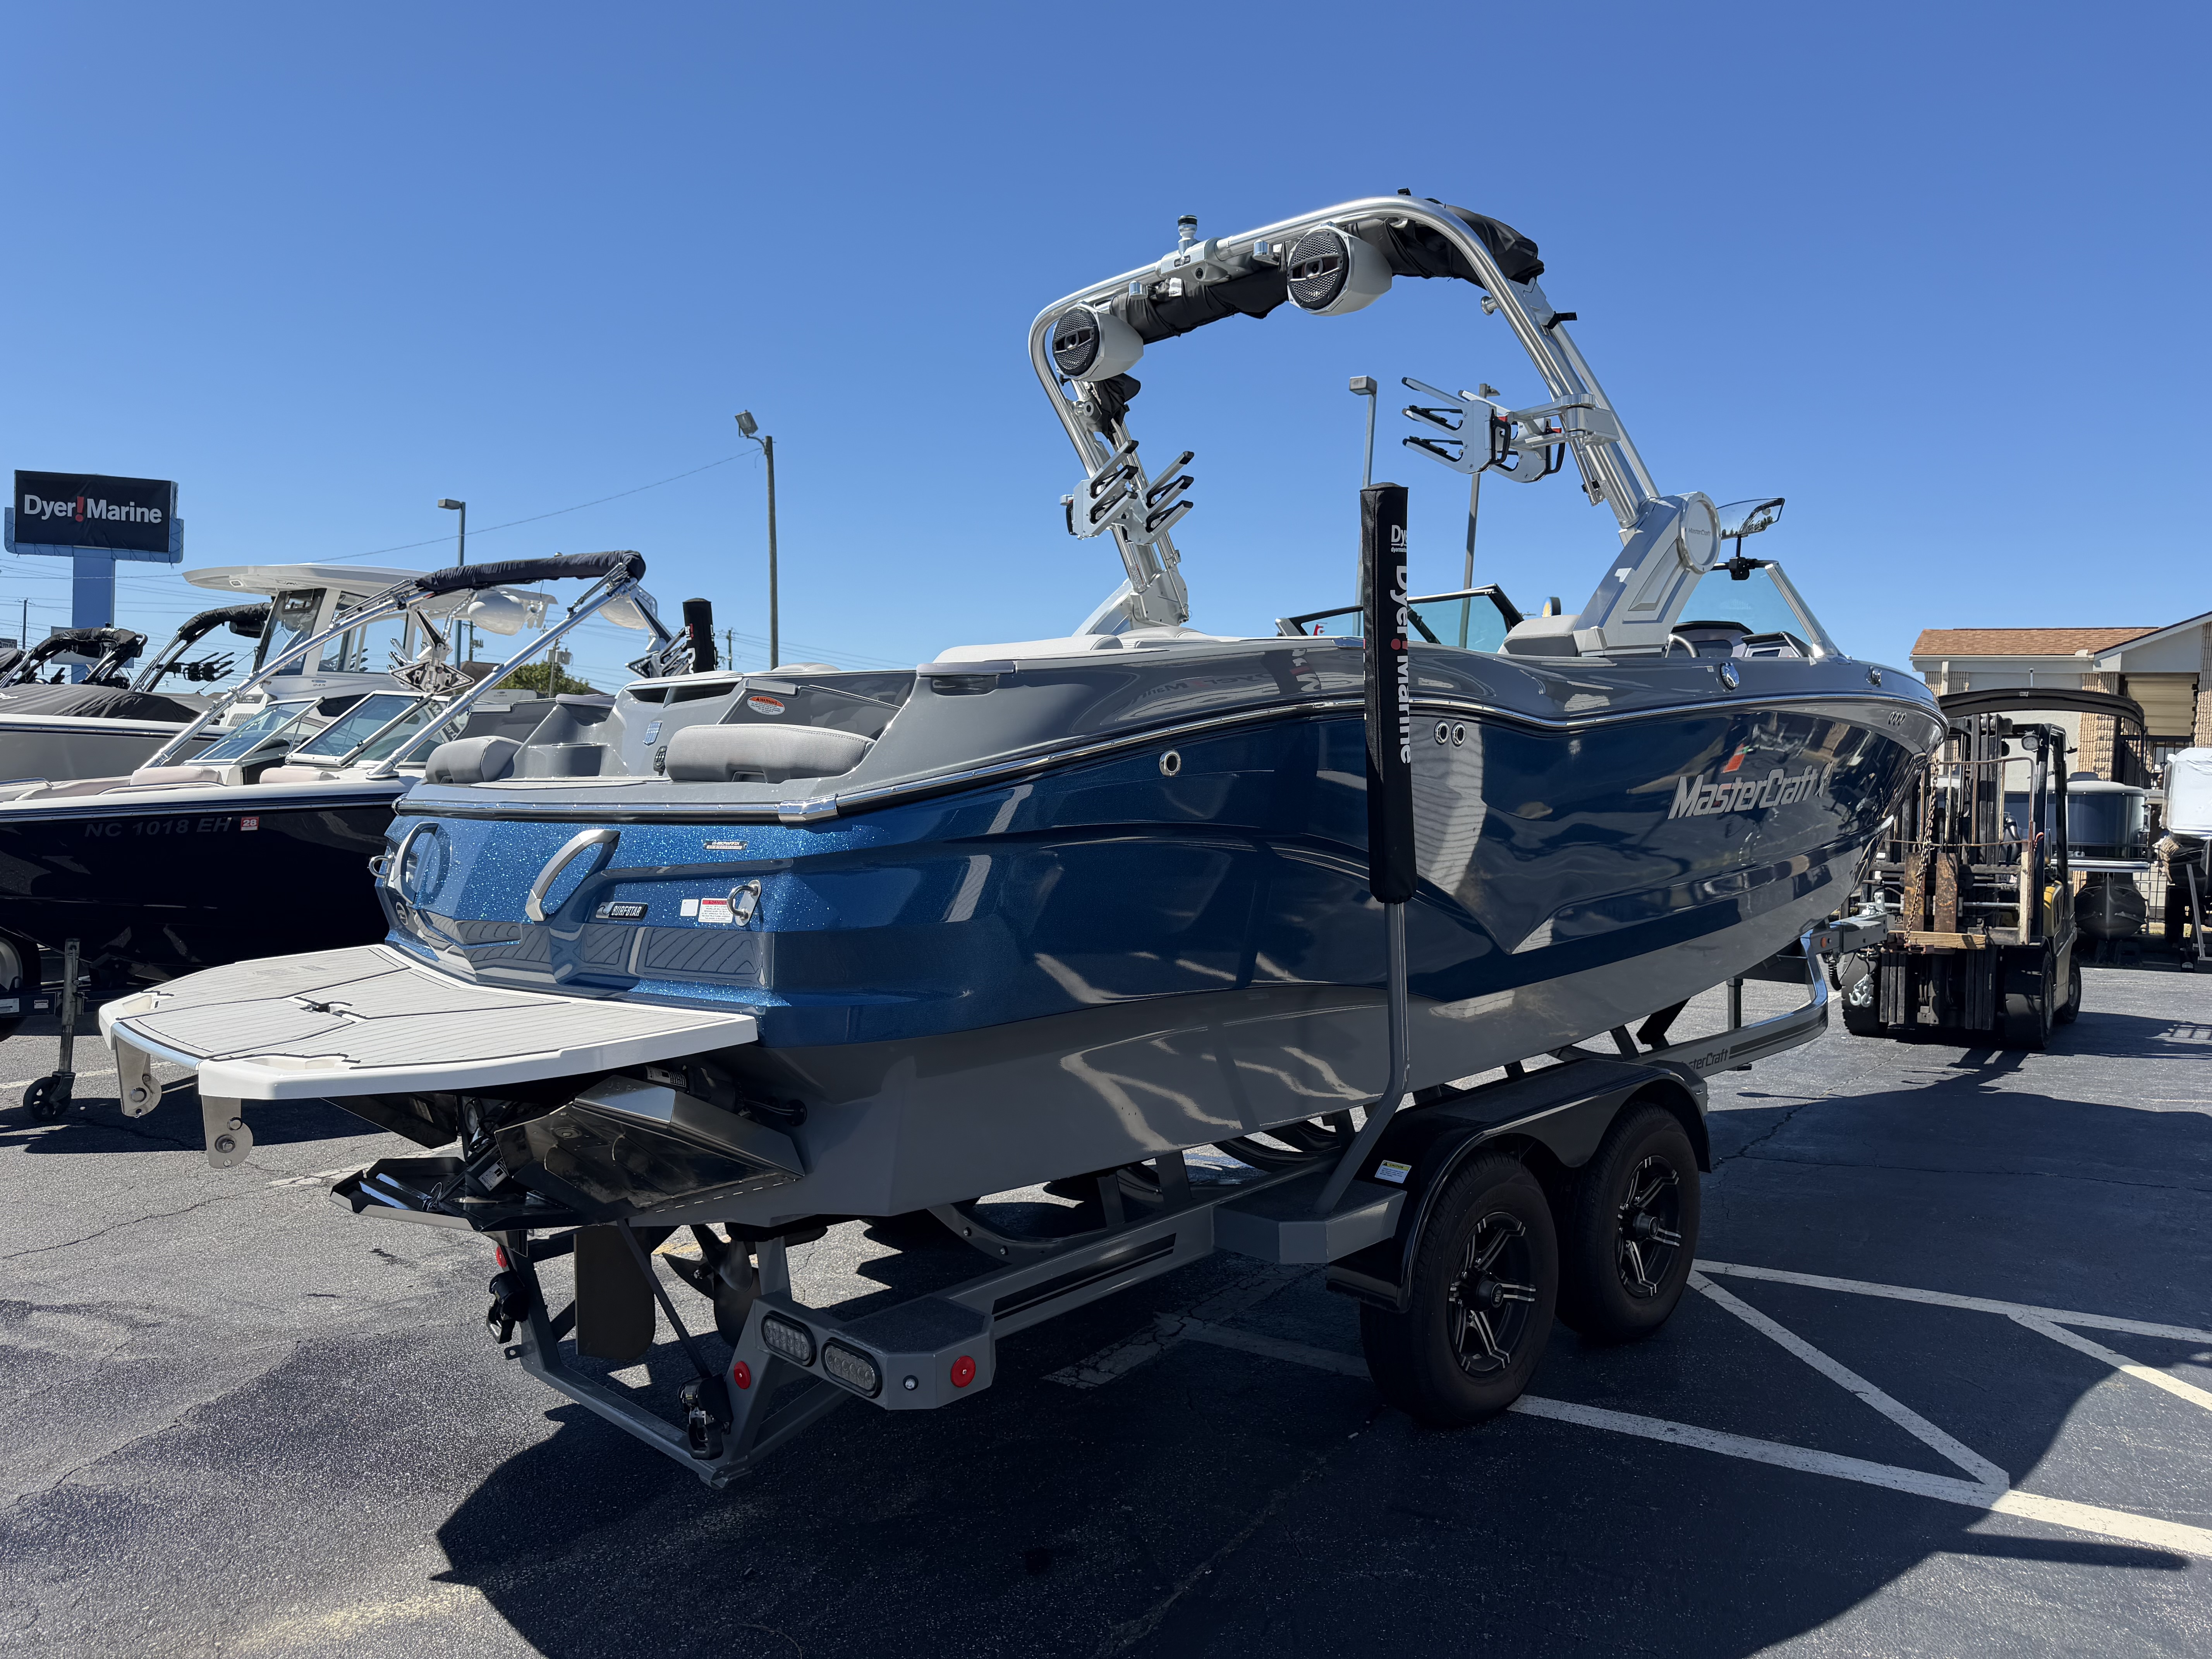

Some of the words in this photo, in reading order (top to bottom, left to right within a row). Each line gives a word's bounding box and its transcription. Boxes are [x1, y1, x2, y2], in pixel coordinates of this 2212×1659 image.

[1668, 765, 1819, 820] MasterCraft
[84, 823, 122, 837] NC
[132, 819, 189, 836] 1018
[196, 817, 232, 832] EH
[611, 905, 642, 916] SURFSTAR
[1688, 1048, 1728, 1070] sterCraft
